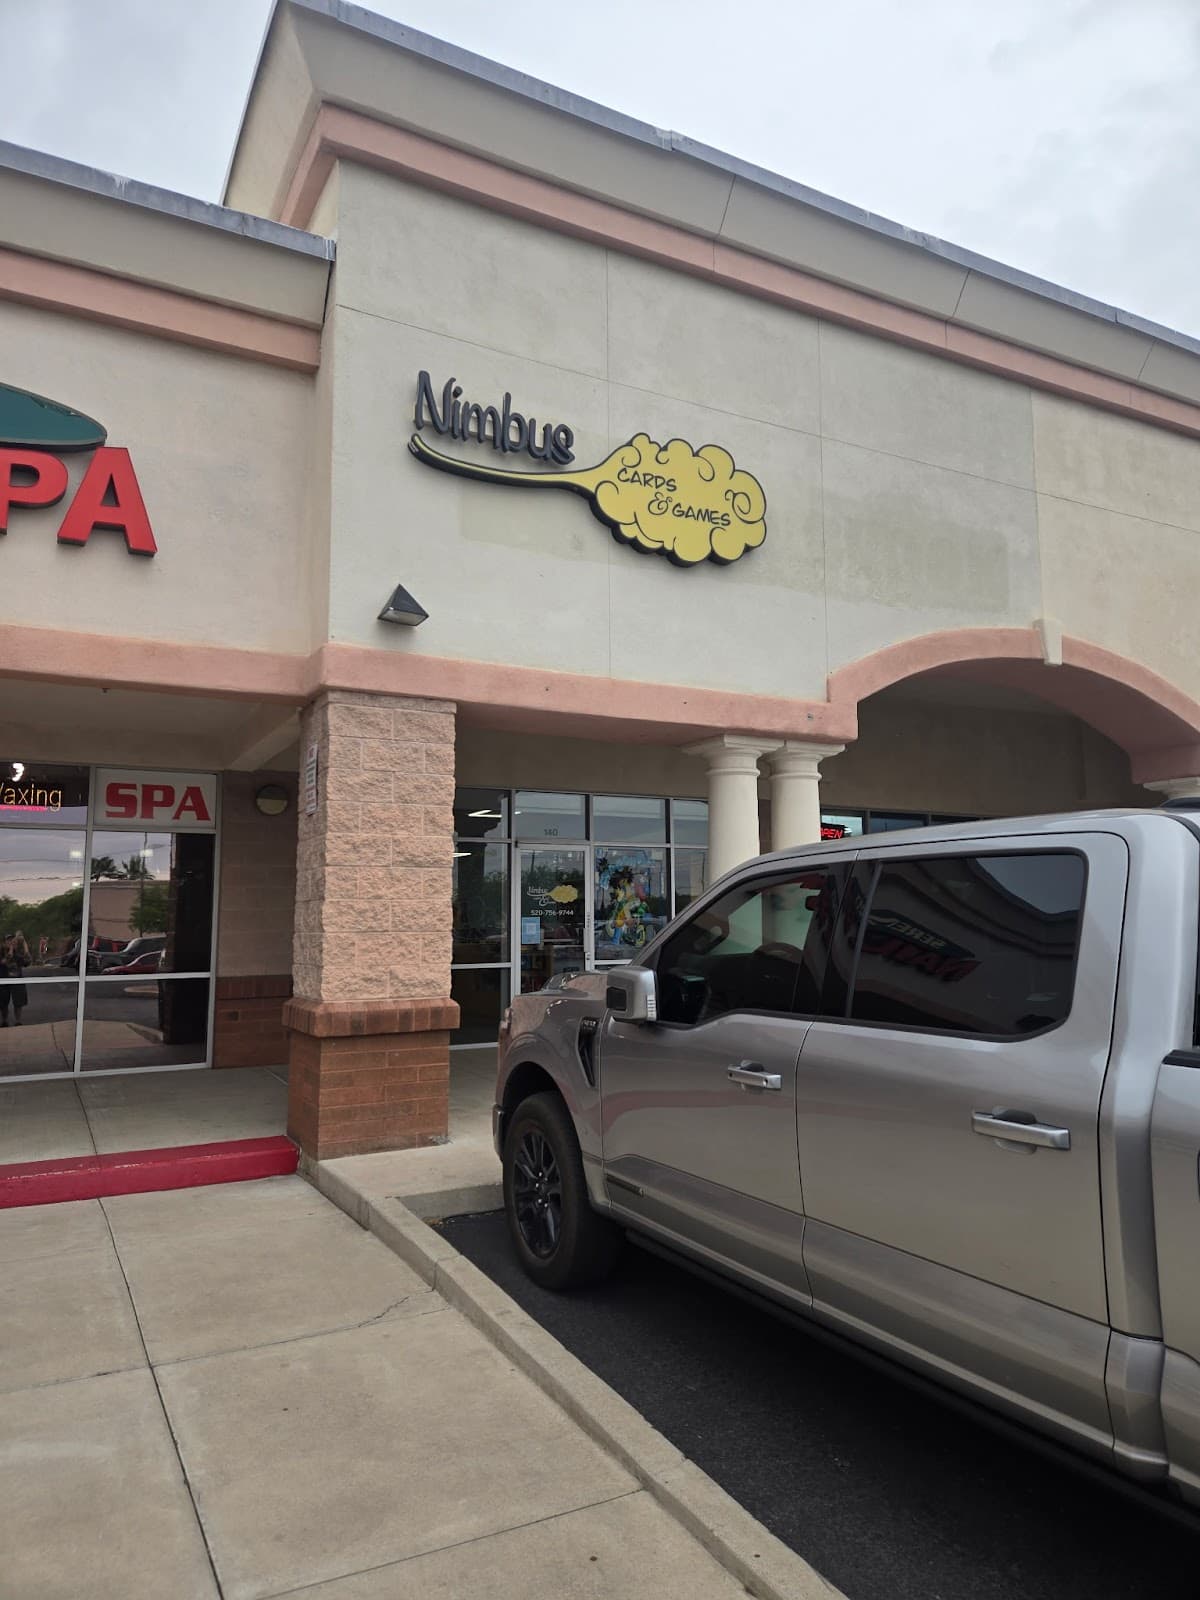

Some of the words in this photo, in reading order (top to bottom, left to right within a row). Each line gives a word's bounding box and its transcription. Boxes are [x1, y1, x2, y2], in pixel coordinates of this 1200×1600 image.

[414, 370, 576, 465] Nimbus
[617, 468, 678, 492] CARDS
[648, 492, 673, 516] &
[672, 503, 732, 527] GAMES
[0, 782, 62, 812] axing
[105, 782, 211, 821] SPA
[819, 827, 844, 839] PEN
